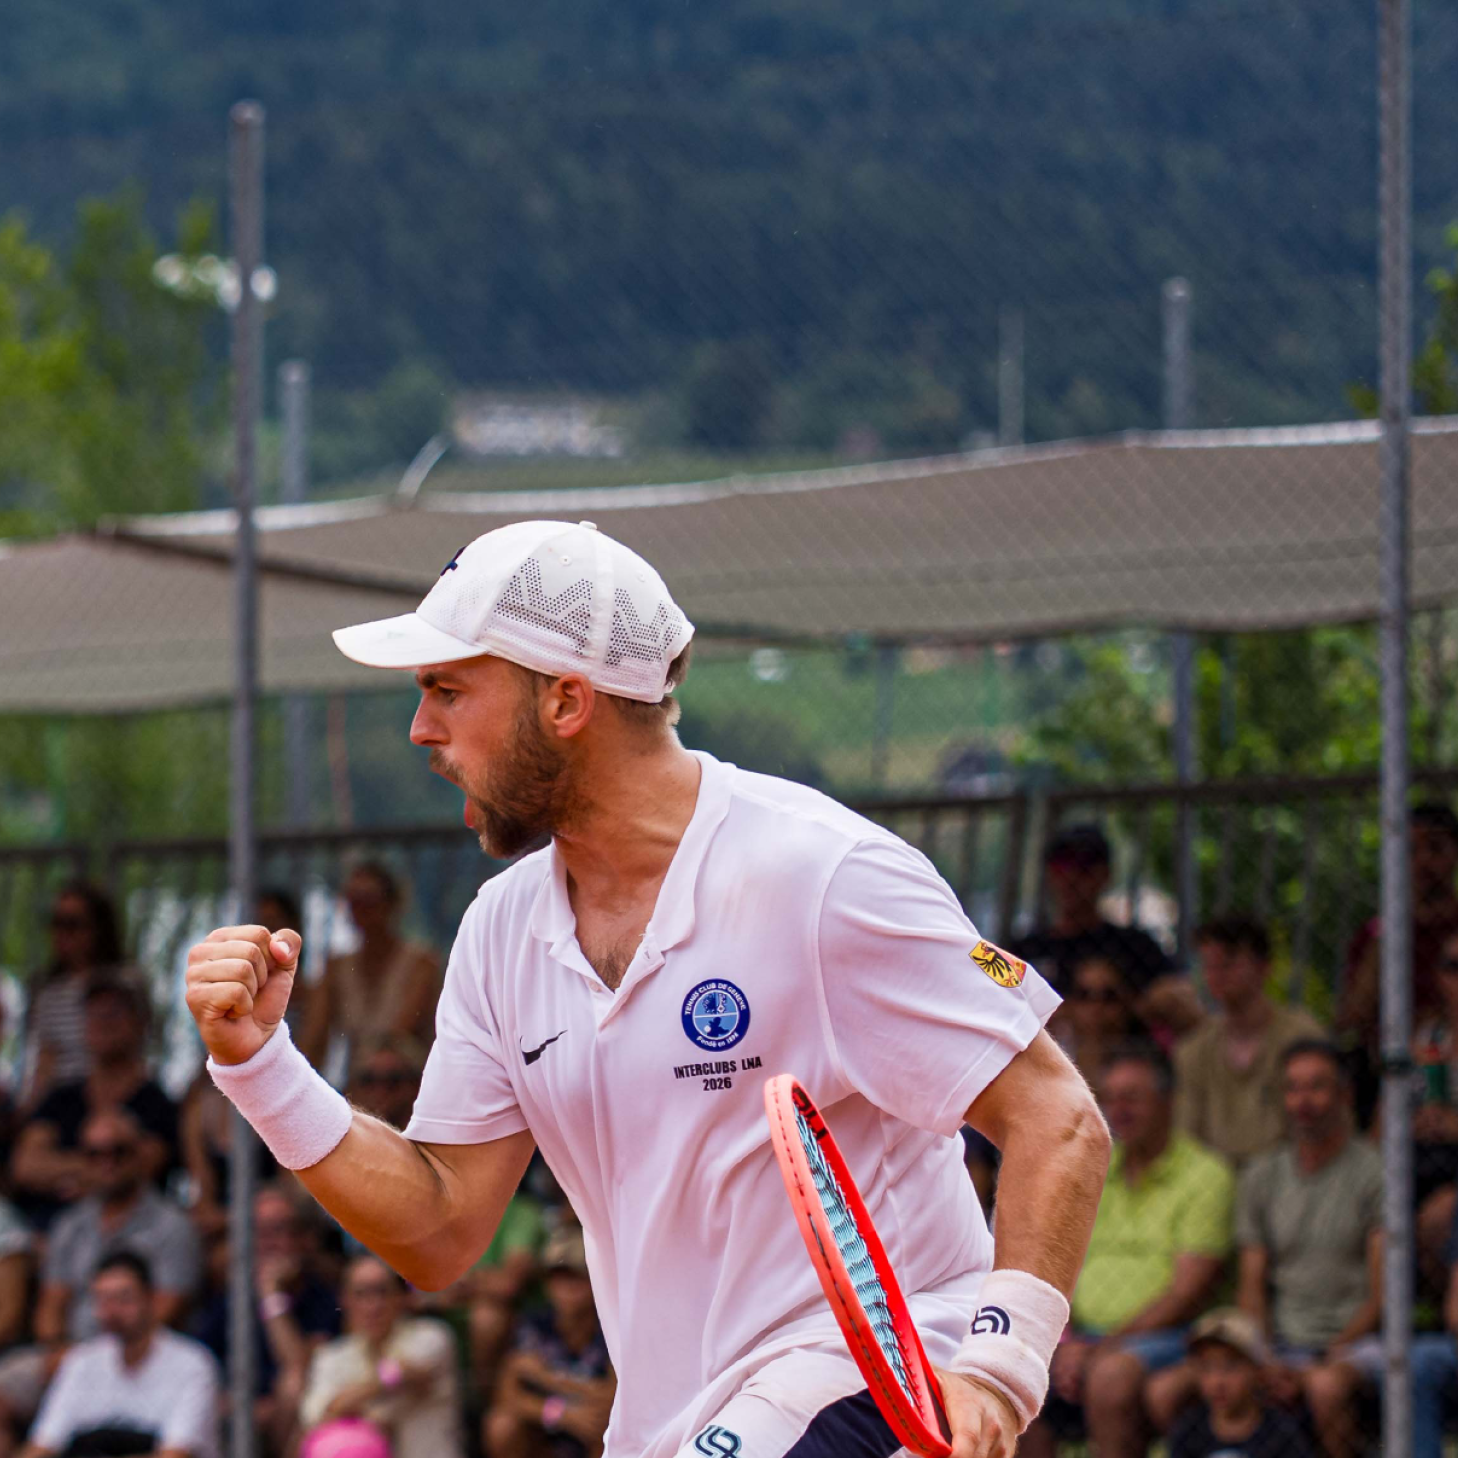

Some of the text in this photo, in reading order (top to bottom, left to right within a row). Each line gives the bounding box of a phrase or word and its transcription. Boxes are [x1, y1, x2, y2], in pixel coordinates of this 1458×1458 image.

[685, 991, 700, 1015] TENNIS
[698, 982, 716, 993] CLUB
[717, 982, 728, 990] DE
[673, 1056, 763, 1079] INTERCLUBS LNA
[703, 1077, 732, 1091] 2026
